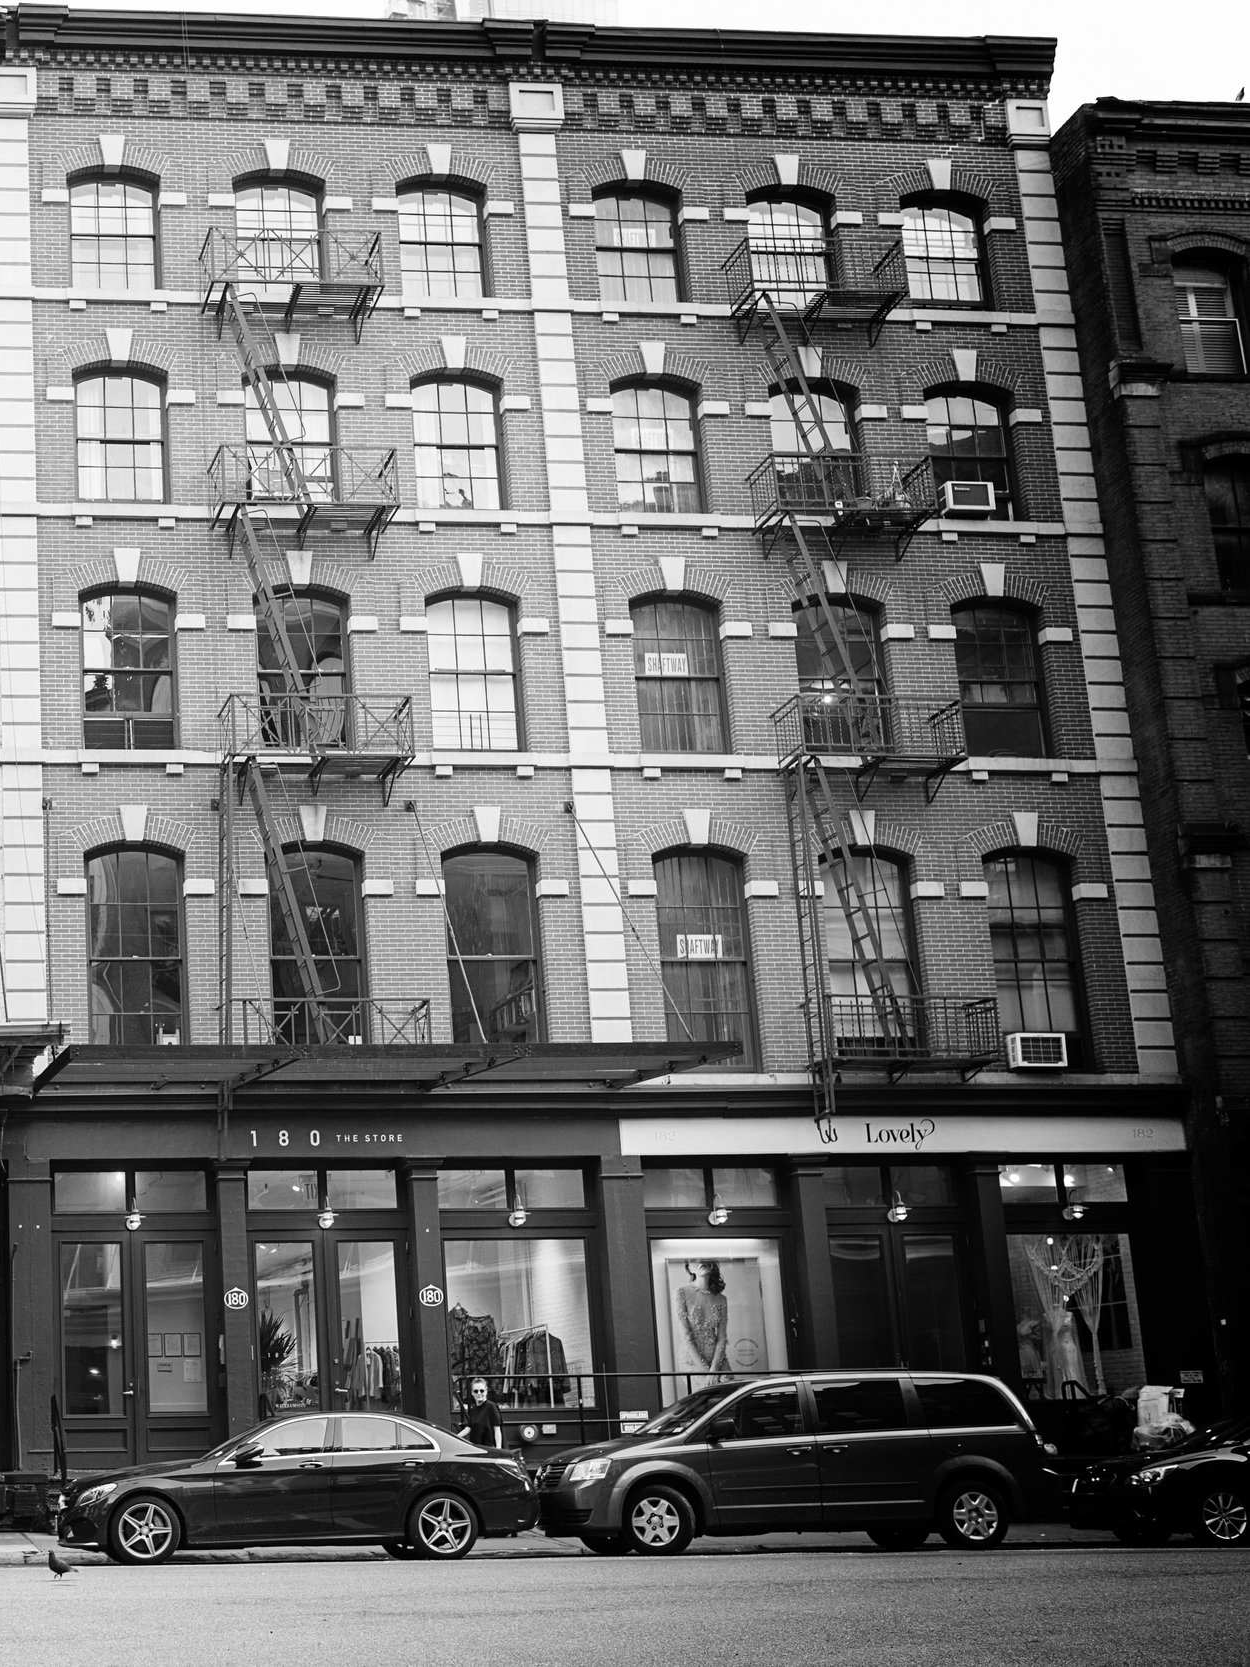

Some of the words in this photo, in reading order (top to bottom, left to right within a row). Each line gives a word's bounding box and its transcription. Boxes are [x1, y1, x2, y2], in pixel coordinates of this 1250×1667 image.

[648, 657, 686, 672] SHAFTWAY
[680, 939, 720, 954] SAFTWAY
[336, 1134, 359, 1142] THE
[365, 1134, 403, 1142] STORE
[654, 1131, 676, 1141] 182
[865, 1119, 935, 1150] Lovely
[1133, 1129, 1153, 1138] 182
[227, 1293, 246, 1306] 180
[423, 1290, 441, 1303] 180
